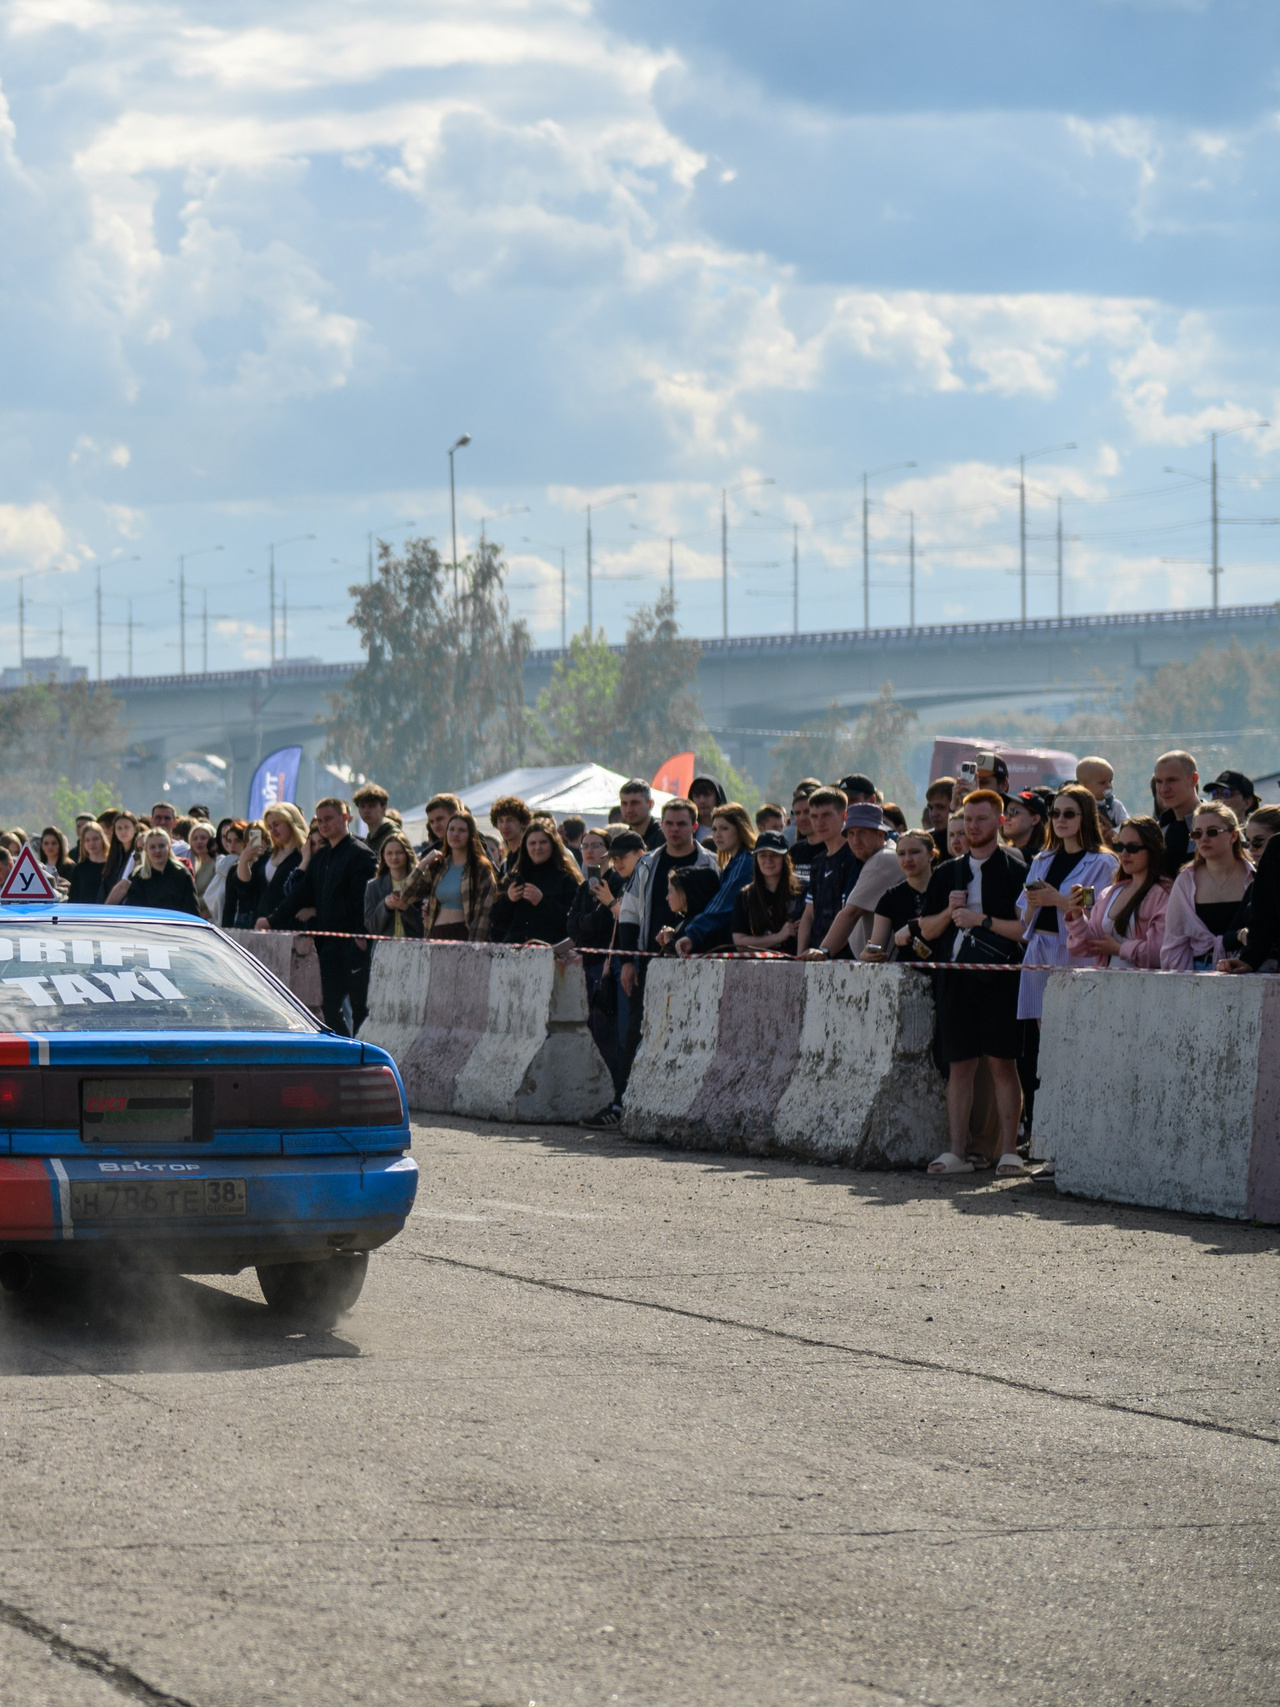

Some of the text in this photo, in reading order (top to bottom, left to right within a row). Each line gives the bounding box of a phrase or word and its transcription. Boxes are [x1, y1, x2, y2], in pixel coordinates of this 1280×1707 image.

[1, 970, 186, 1007] TAXI
[86, 1097, 127, 1112] GO
[207, 1181, 236, 1203] 38
